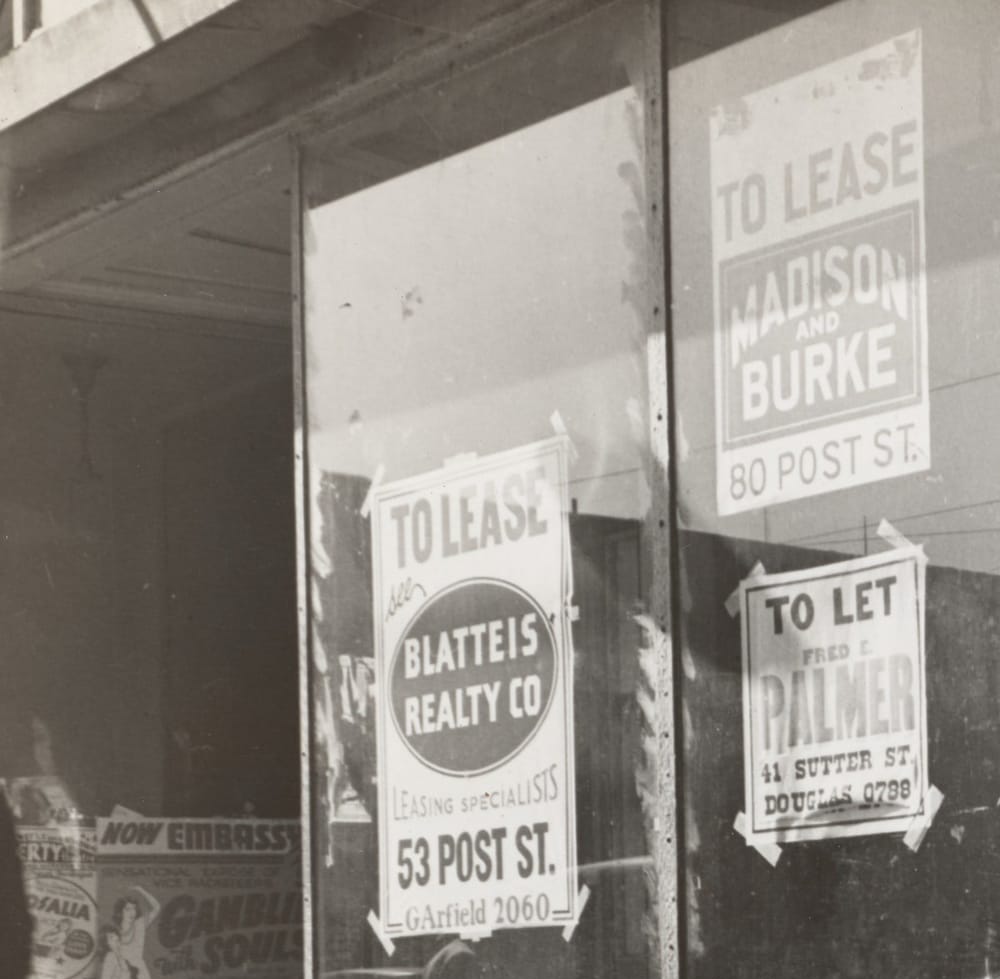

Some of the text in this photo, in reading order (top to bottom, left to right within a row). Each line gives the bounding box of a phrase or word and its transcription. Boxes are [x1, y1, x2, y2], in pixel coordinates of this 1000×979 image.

[718, 119, 919, 243] TO LEASE
[731, 243, 909, 369] MADISON
[795, 310, 840, 341] AND
[741, 323, 898, 422] BURKE
[730, 423, 919, 501] 80 POST ST.
[390, 465, 549, 569] TO LEASE
[765, 576, 898, 635] TO LET
[404, 612, 538, 679] BLATTEIS
[803, 643, 850, 666] FRED
[405, 674, 541, 737] REALTY CO
[760, 654, 916, 755] PALMER
[393, 763, 559, 821] LEASING SPECIALISTS
[761, 762, 782, 783] 41
[795, 750, 873, 780] SUTTER
[765, 785, 853, 816] DOUGLAS
[101, 822, 164, 846] NOW
[397, 822, 556, 890] 53 POST ST.
[405, 893, 550, 932] GArfield 2060
